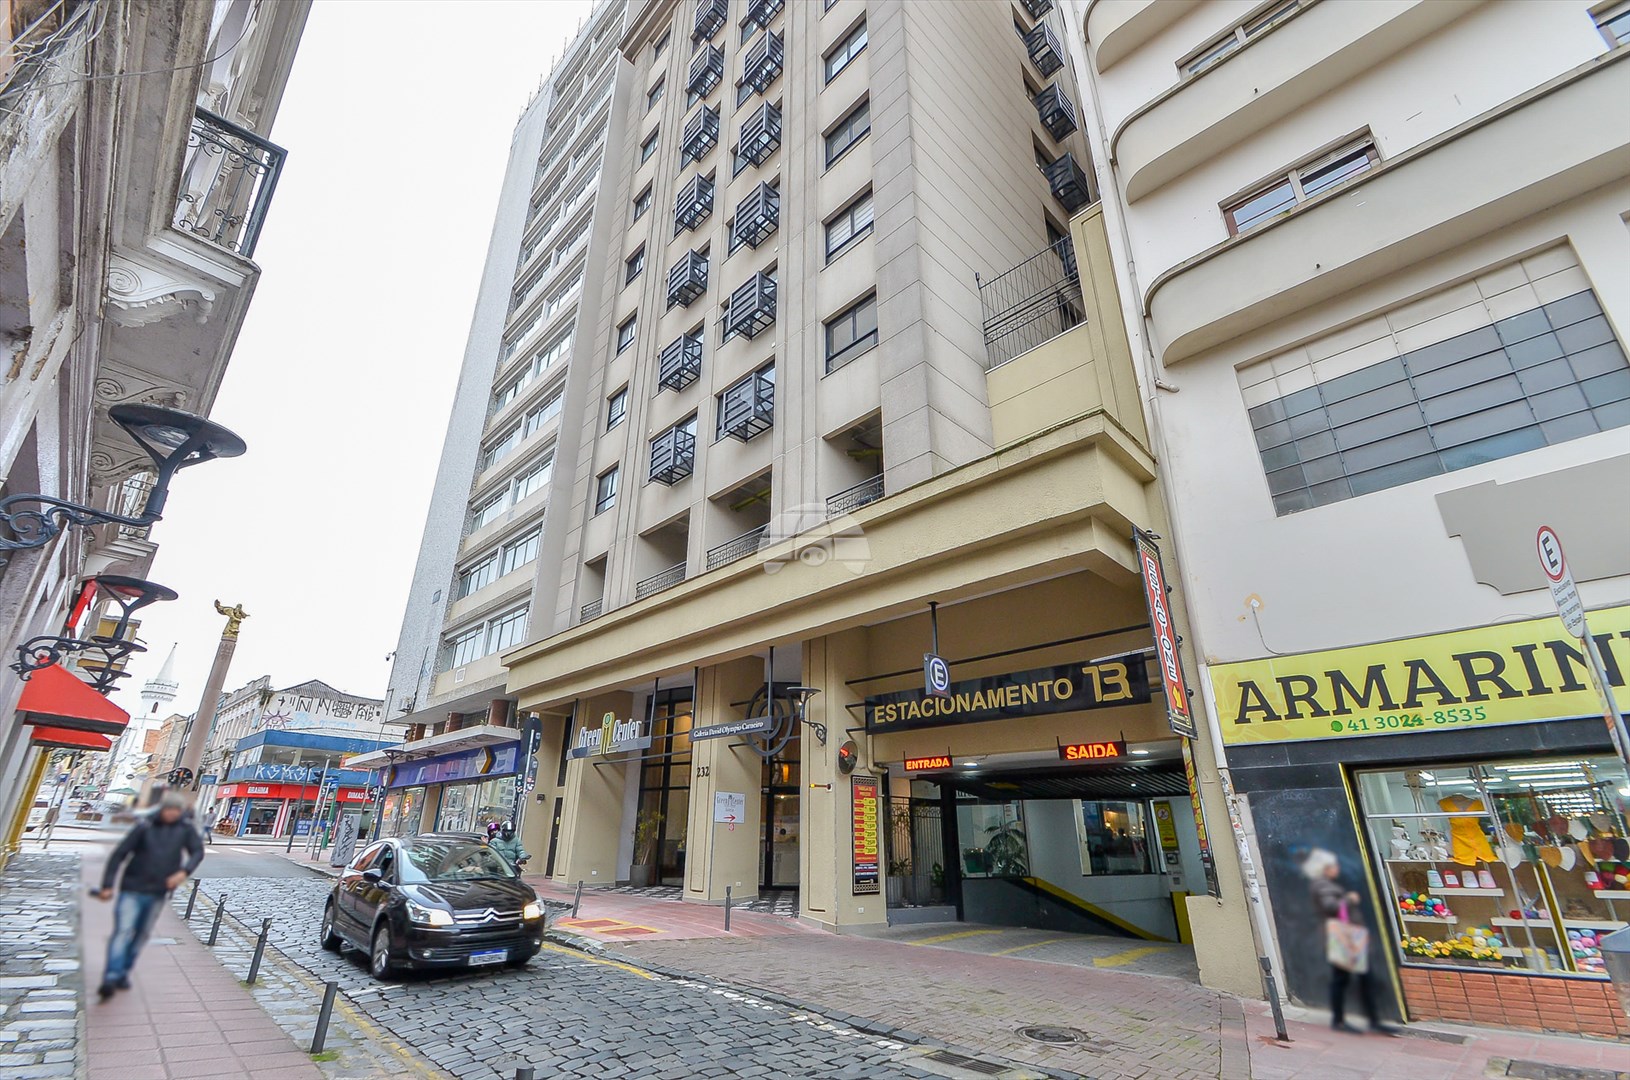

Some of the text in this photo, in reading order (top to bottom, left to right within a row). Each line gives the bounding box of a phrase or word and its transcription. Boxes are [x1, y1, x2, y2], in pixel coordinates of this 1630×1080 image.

[1541, 535, 1559, 570] E
[1147, 557, 1177, 682] ESTACIONE
[934, 663, 945, 686] E
[1234, 630, 1630, 724] ARMARIN
[874, 678, 1074, 724] ESTACIONAMENTO
[1347, 706, 1487, 732] 41 3024-8535
[578, 718, 643, 748] Green Center
[693, 729, 709, 738] Galeria
[905, 757, 950, 770] ENTRADA
[1066, 743, 1118, 760] SAIDA
[696, 766, 710, 778] 232
